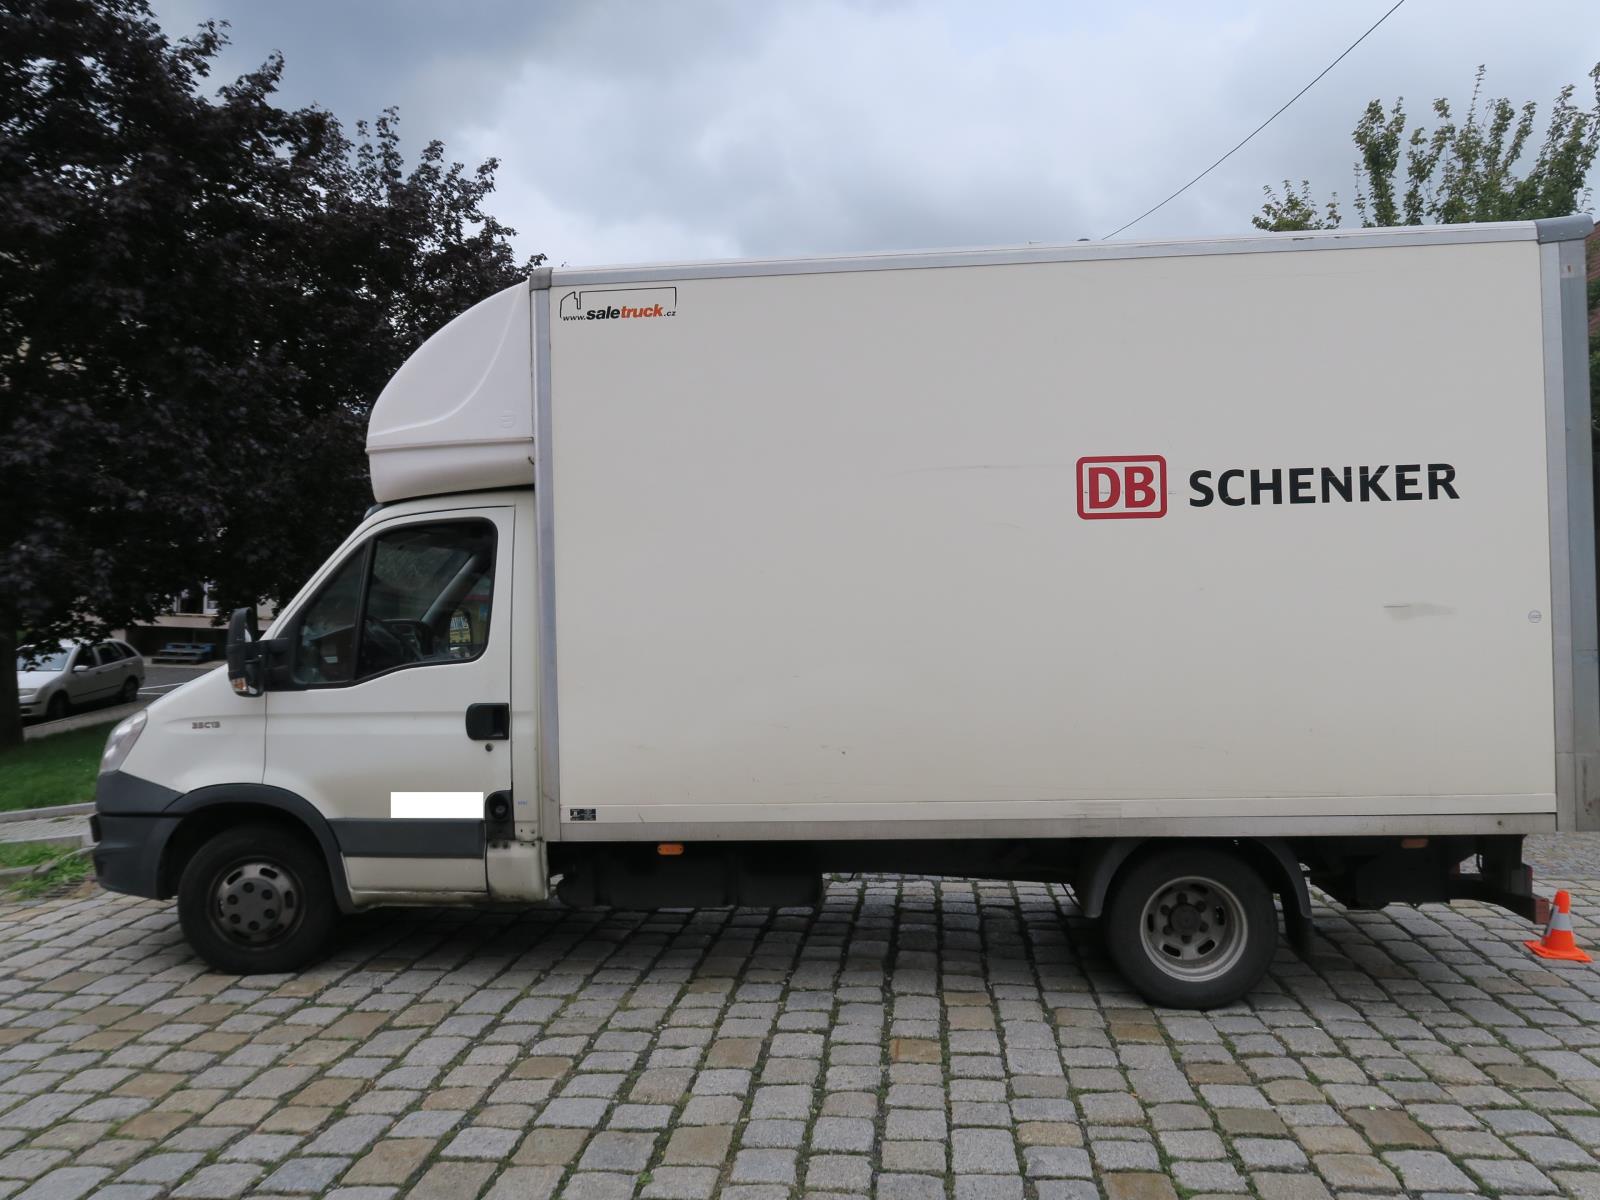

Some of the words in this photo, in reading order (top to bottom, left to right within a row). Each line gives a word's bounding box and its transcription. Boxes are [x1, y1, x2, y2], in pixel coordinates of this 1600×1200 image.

[562, 303, 676, 321] www.saletruck.cz
[1087, 466, 1157, 509] DB
[1189, 463, 1461, 508] SCHENKER
